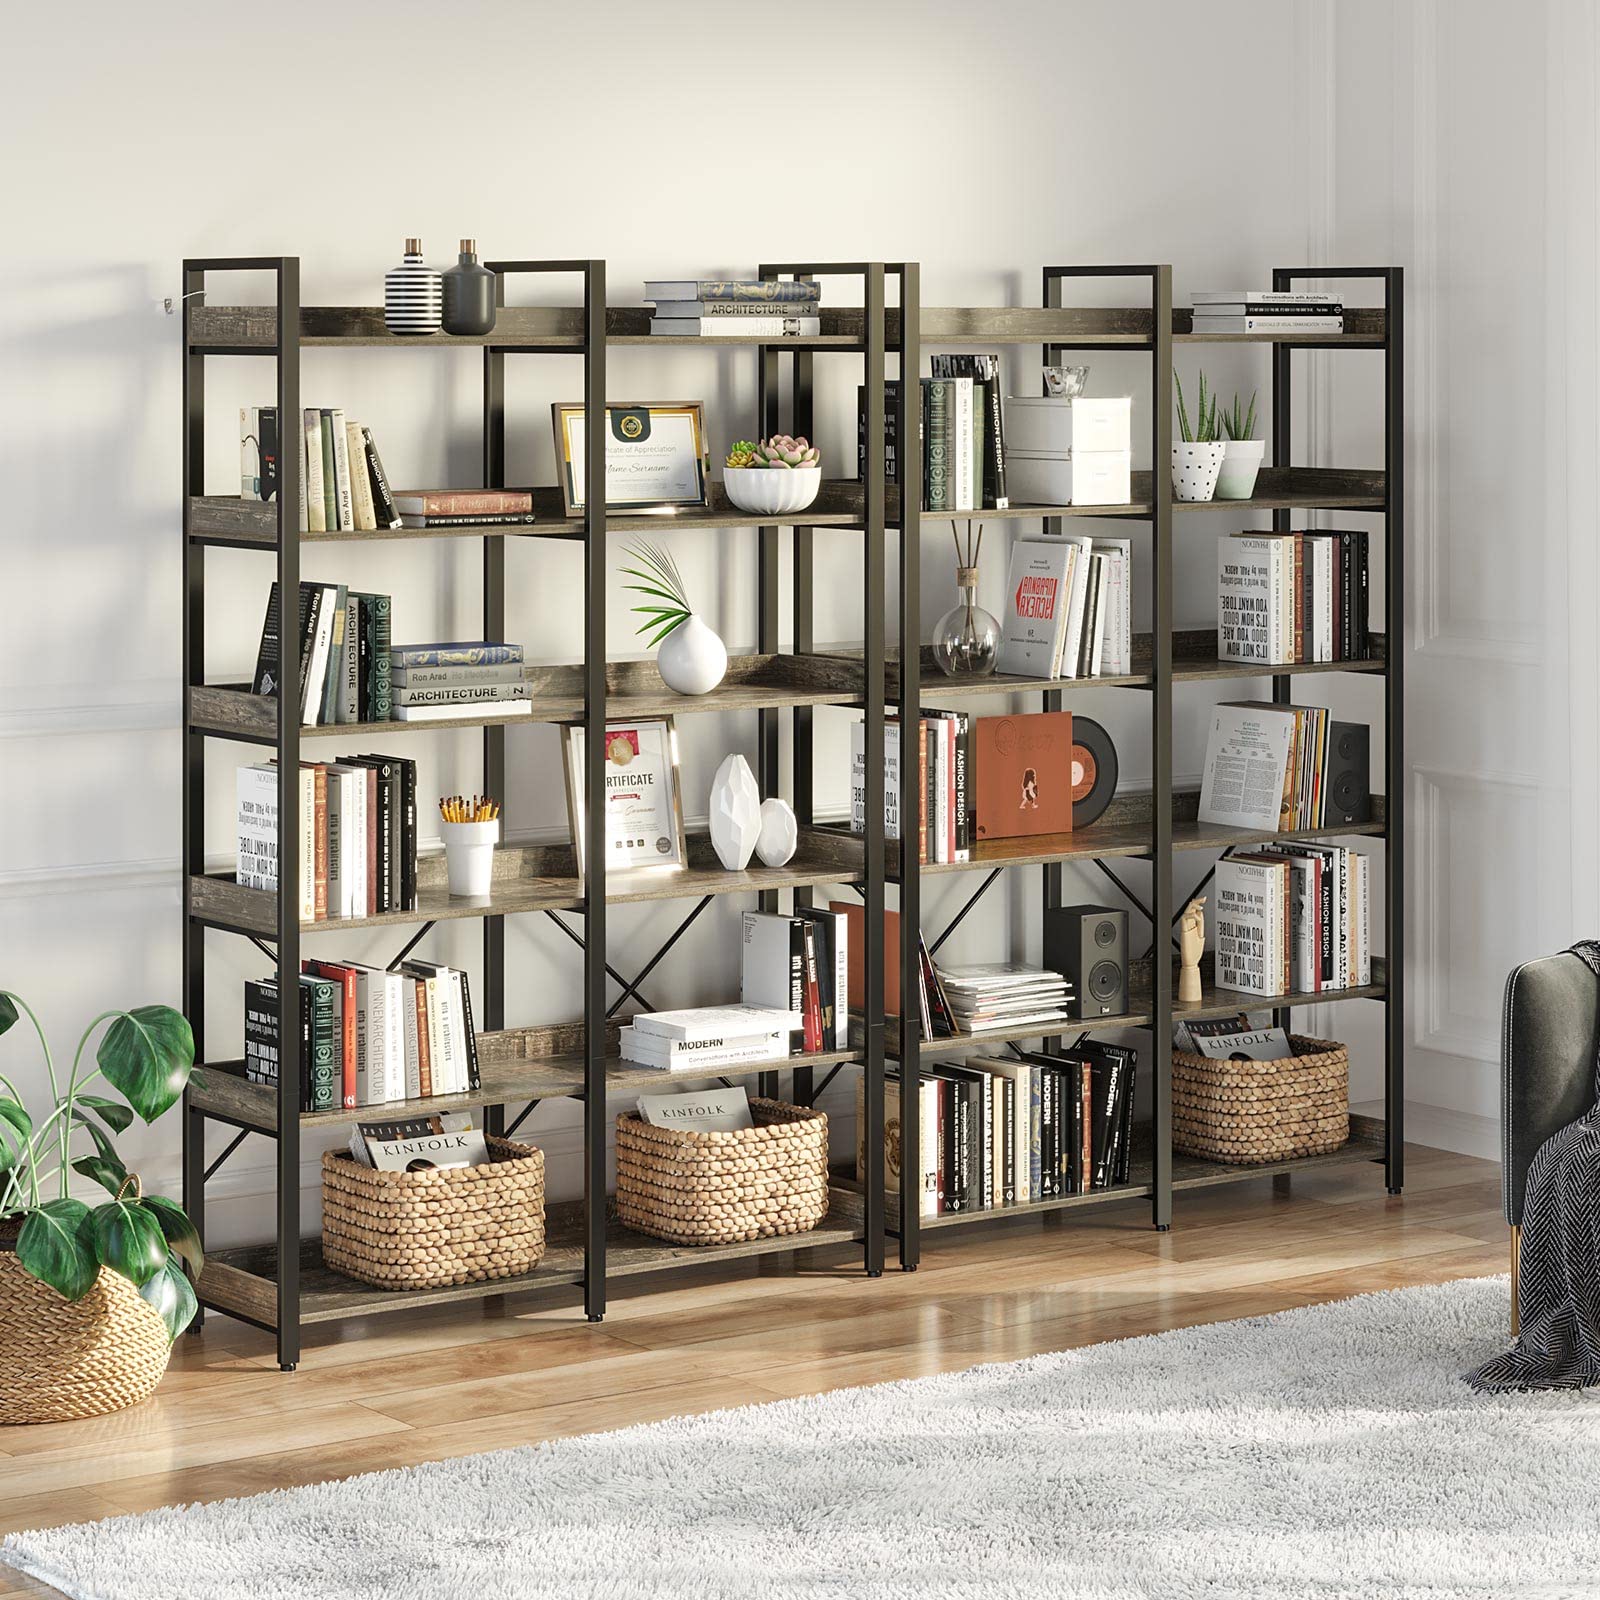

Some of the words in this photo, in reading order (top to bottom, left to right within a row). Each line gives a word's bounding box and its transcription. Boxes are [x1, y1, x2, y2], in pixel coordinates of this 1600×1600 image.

[711, 304, 788, 314] ARCHITECTURE
[992, 393, 1000, 436] FASHION
[634, 446, 676, 454] Appreciation
[995, 437, 1003, 473] DESIGN
[369, 453, 384, 482] FASHION
[379, 480, 393, 506] DESIGN
[1240, 566, 1250, 576] PAUL
[312, 593, 320, 610] Ron
[1238, 597, 1255, 611] WANT
[1256, 598, 1268, 612] YOU
[308, 612, 316, 634] Arad
[1224, 611, 1240, 626] GOOD
[1241, 612, 1255, 626] HOW
[1256, 613, 1268, 628] IT'S
[1237, 627, 1250, 641] YOU
[1252, 628, 1268, 643] GOOD
[348, 605, 356, 689] ARCHITECTURE
[1226, 642, 1240, 656] HOW
[1242, 643, 1254, 657] NOT
[1256, 644, 1268, 659] IT'S
[412, 673, 428, 681] Ron
[429, 672, 447, 680] Arad
[409, 688, 498, 701] ARCHITECTURE
[956, 750, 965, 790] FASHION
[606, 774, 654, 787] RTIFICATE
[957, 791, 965, 826] DESIGN
[1322, 886, 1330, 926] FASHION
[1235, 924, 1251, 940] WANT
[1252, 926, 1264, 942] YOU
[1220, 938, 1236, 953] GOOD
[1238, 940, 1250, 956] HOW
[1252, 943, 1264, 958] IT'S
[1234, 956, 1246, 970] YOU
[1248, 958, 1264, 974] GOOD
[1224, 970, 1236, 984] HOW
[1239, 972, 1250, 988] NOT
[1252, 974, 1264, 990] IT'S
[373, 990, 385, 1098] INNENARCHITEKTUR
[407, 997, 419, 1092] INNENARCHITEKTUR
[678, 1038, 724, 1051] MODERN
[1208, 1033, 1274, 1050] KINFOLK
[1106, 1067, 1118, 1116] MODERN
[662, 1105, 725, 1118] KINFOLK
[383, 1136, 468, 1156] KINFOLK
[1097, 1167, 1103, 1178] A
[1044, 1177, 1050, 1188] A
